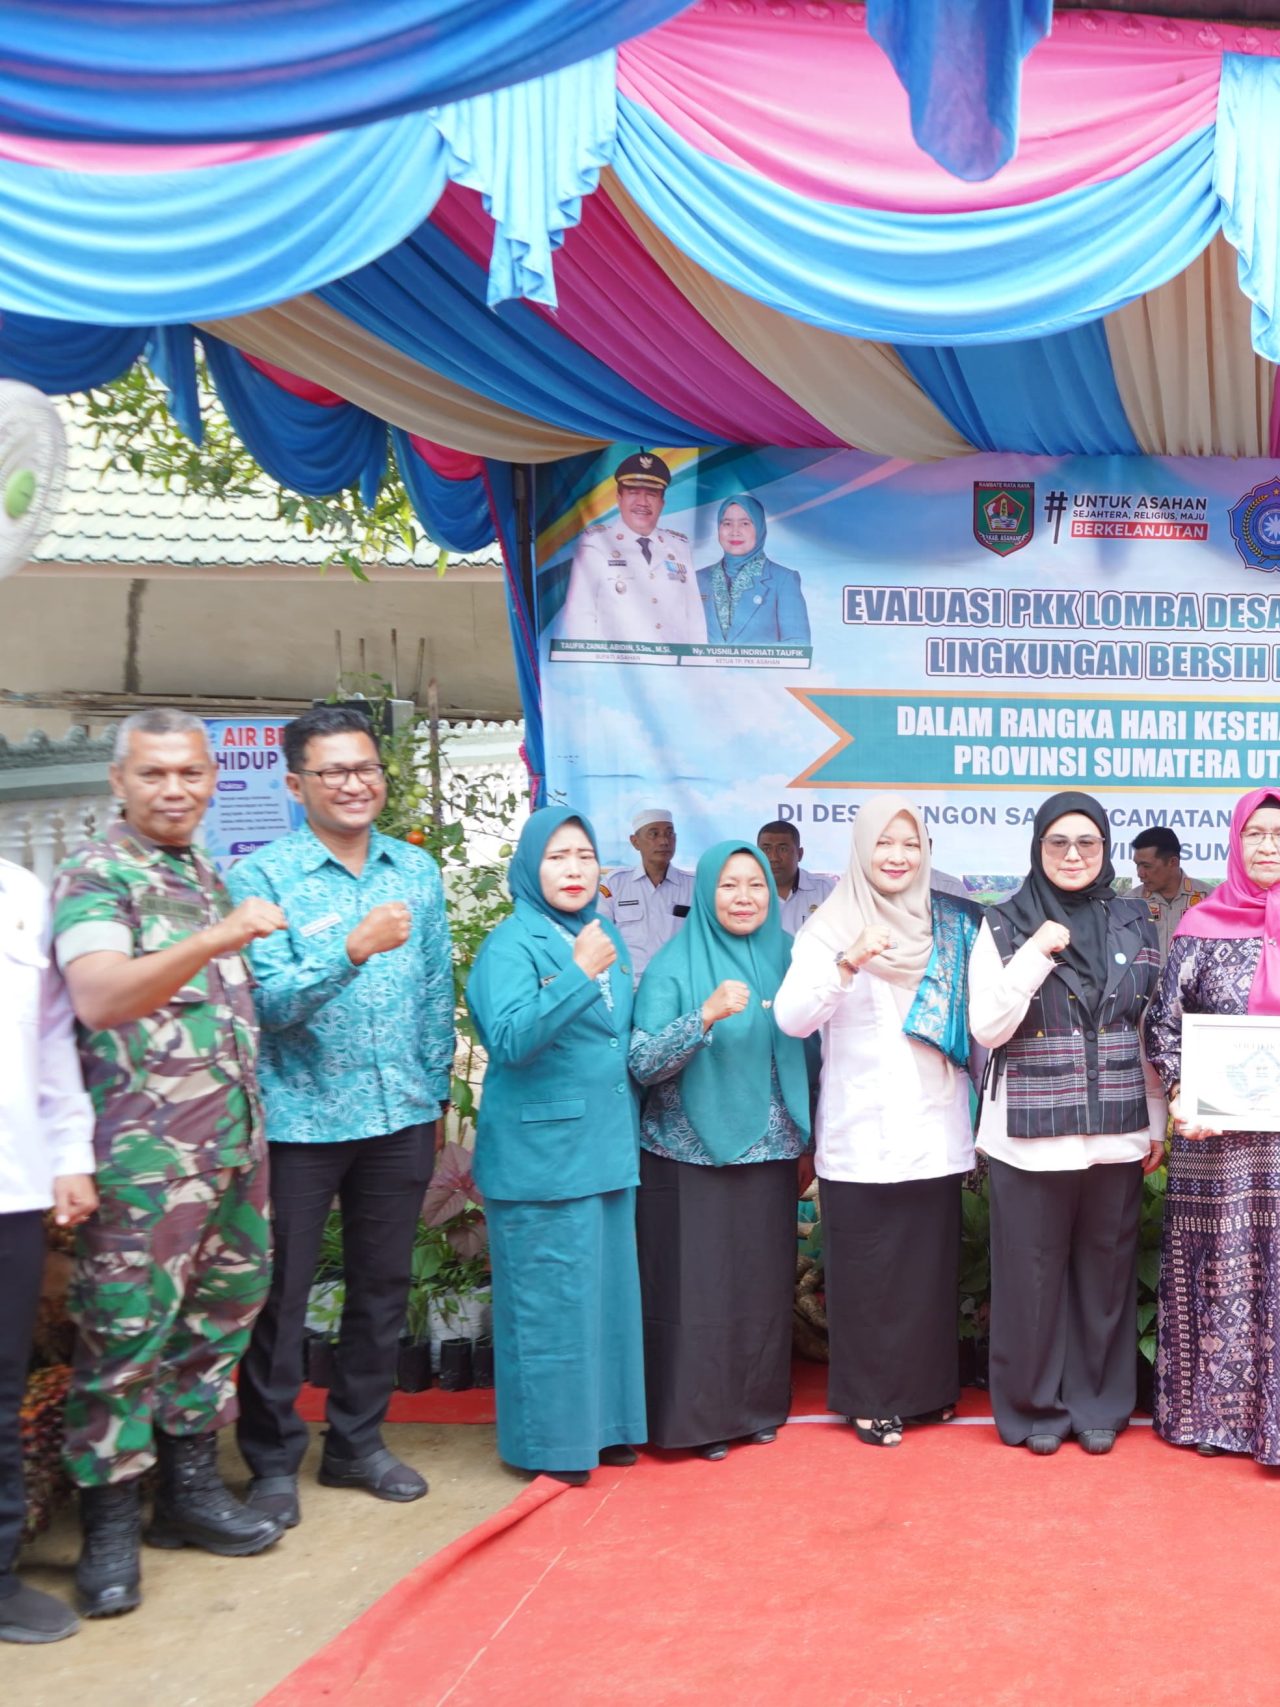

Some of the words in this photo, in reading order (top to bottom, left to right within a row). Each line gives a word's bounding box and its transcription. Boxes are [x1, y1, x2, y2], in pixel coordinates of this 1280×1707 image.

[1073, 494, 1132, 509] UNTUK
[1136, 496, 1207, 511] ASAHAN
[1072, 510, 1131, 519] SEJAHTERA,
[1134, 511, 1177, 520] RELIGIUS,
[1180, 512, 1205, 521] MAJU
[1073, 522, 1205, 538] BERKELANJUTAN
[845, 587, 1003, 627] EVALUASI
[1009, 591, 1081, 628] PKK
[1084, 592, 1201, 631] LOMBA
[740, 648, 774, 656] INDRIATI
[928, 639, 1141, 679] LINGKUNGAN
[1147, 643, 1268, 681] BERSIH
[897, 705, 993, 738] DALAM
[999, 708, 1115, 739] RANGKA
[1120, 710, 1187, 740] HARI
[223, 726, 258, 746] AIR
[215, 751, 279, 770] HIDUP
[954, 745, 1087, 778] PROVINSI
[1093, 746, 1242, 779] SUMATERA
[777, 803, 803, 822] DI
[811, 803, 861, 823] DES
[917, 805, 997, 825] NGON
[1105, 808, 1232, 829] CAMATAN
